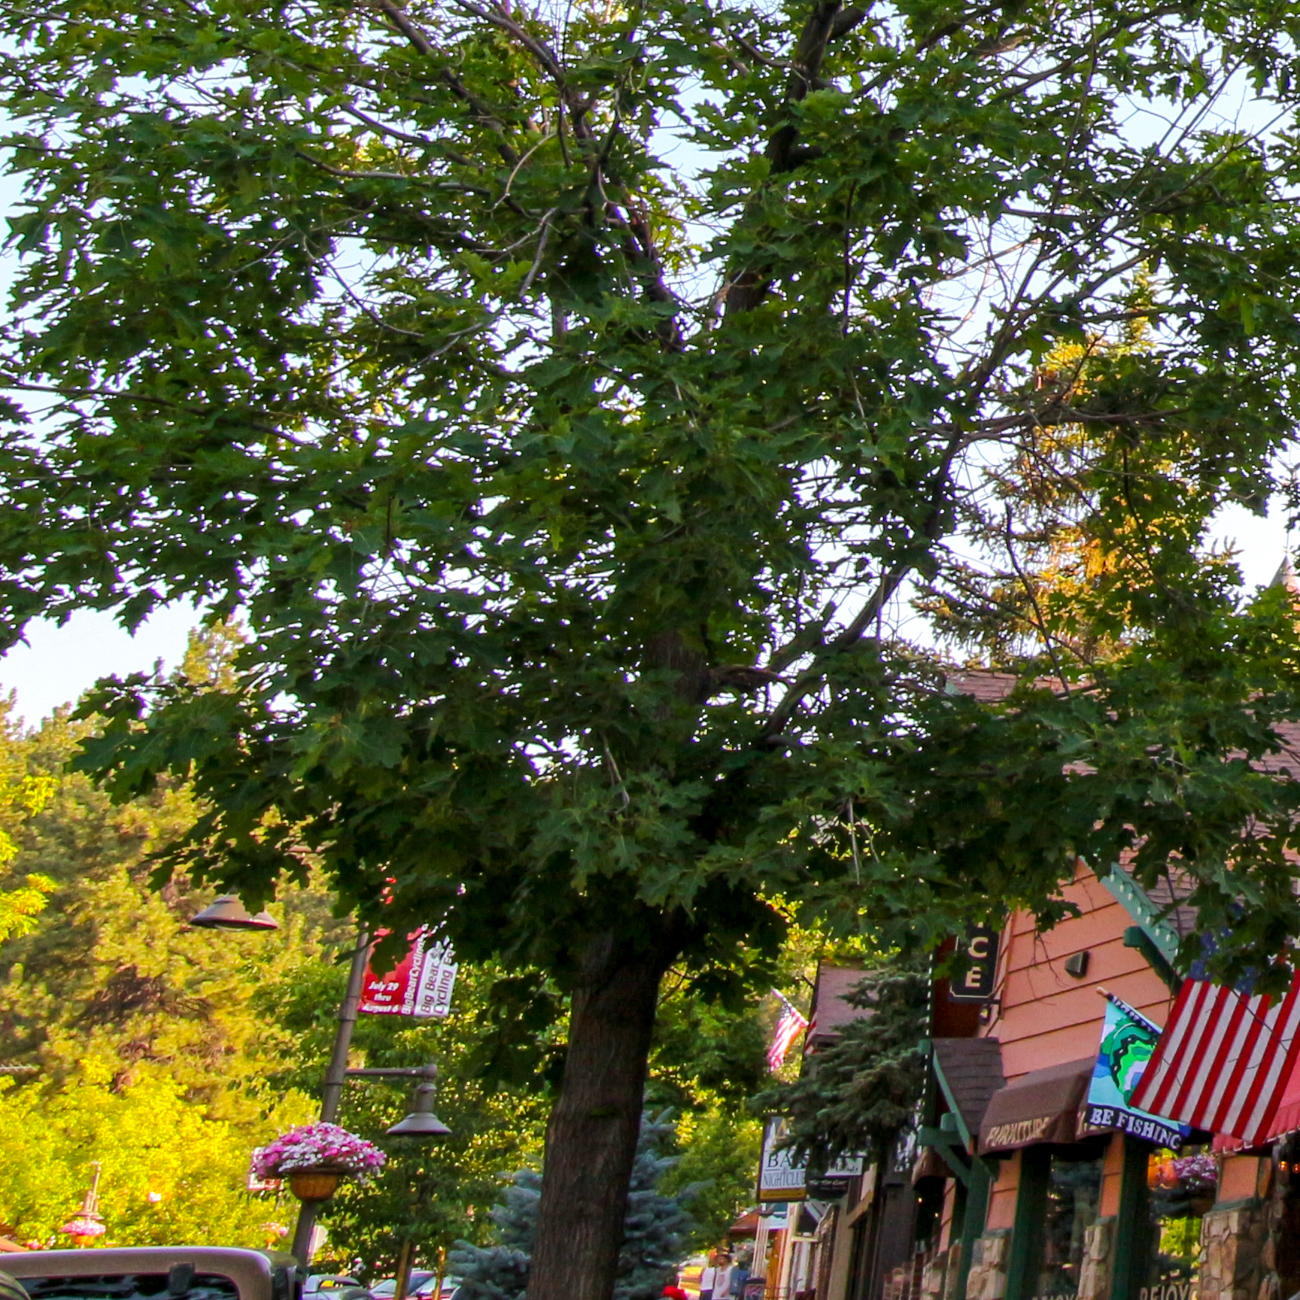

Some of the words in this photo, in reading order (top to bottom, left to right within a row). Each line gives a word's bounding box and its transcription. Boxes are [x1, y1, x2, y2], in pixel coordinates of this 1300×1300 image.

[964, 922, 989, 988] CE
[425, 962, 440, 990] Bear
[368, 982, 386, 991] July
[387, 982, 399, 991] 29
[374, 993, 391, 1001] thru
[362, 1003, 391, 1013] August
[392, 1004, 399, 1012] 6
[1090, 1107, 1115, 1126] BE
[1116, 1110, 1182, 1150] FISHING
